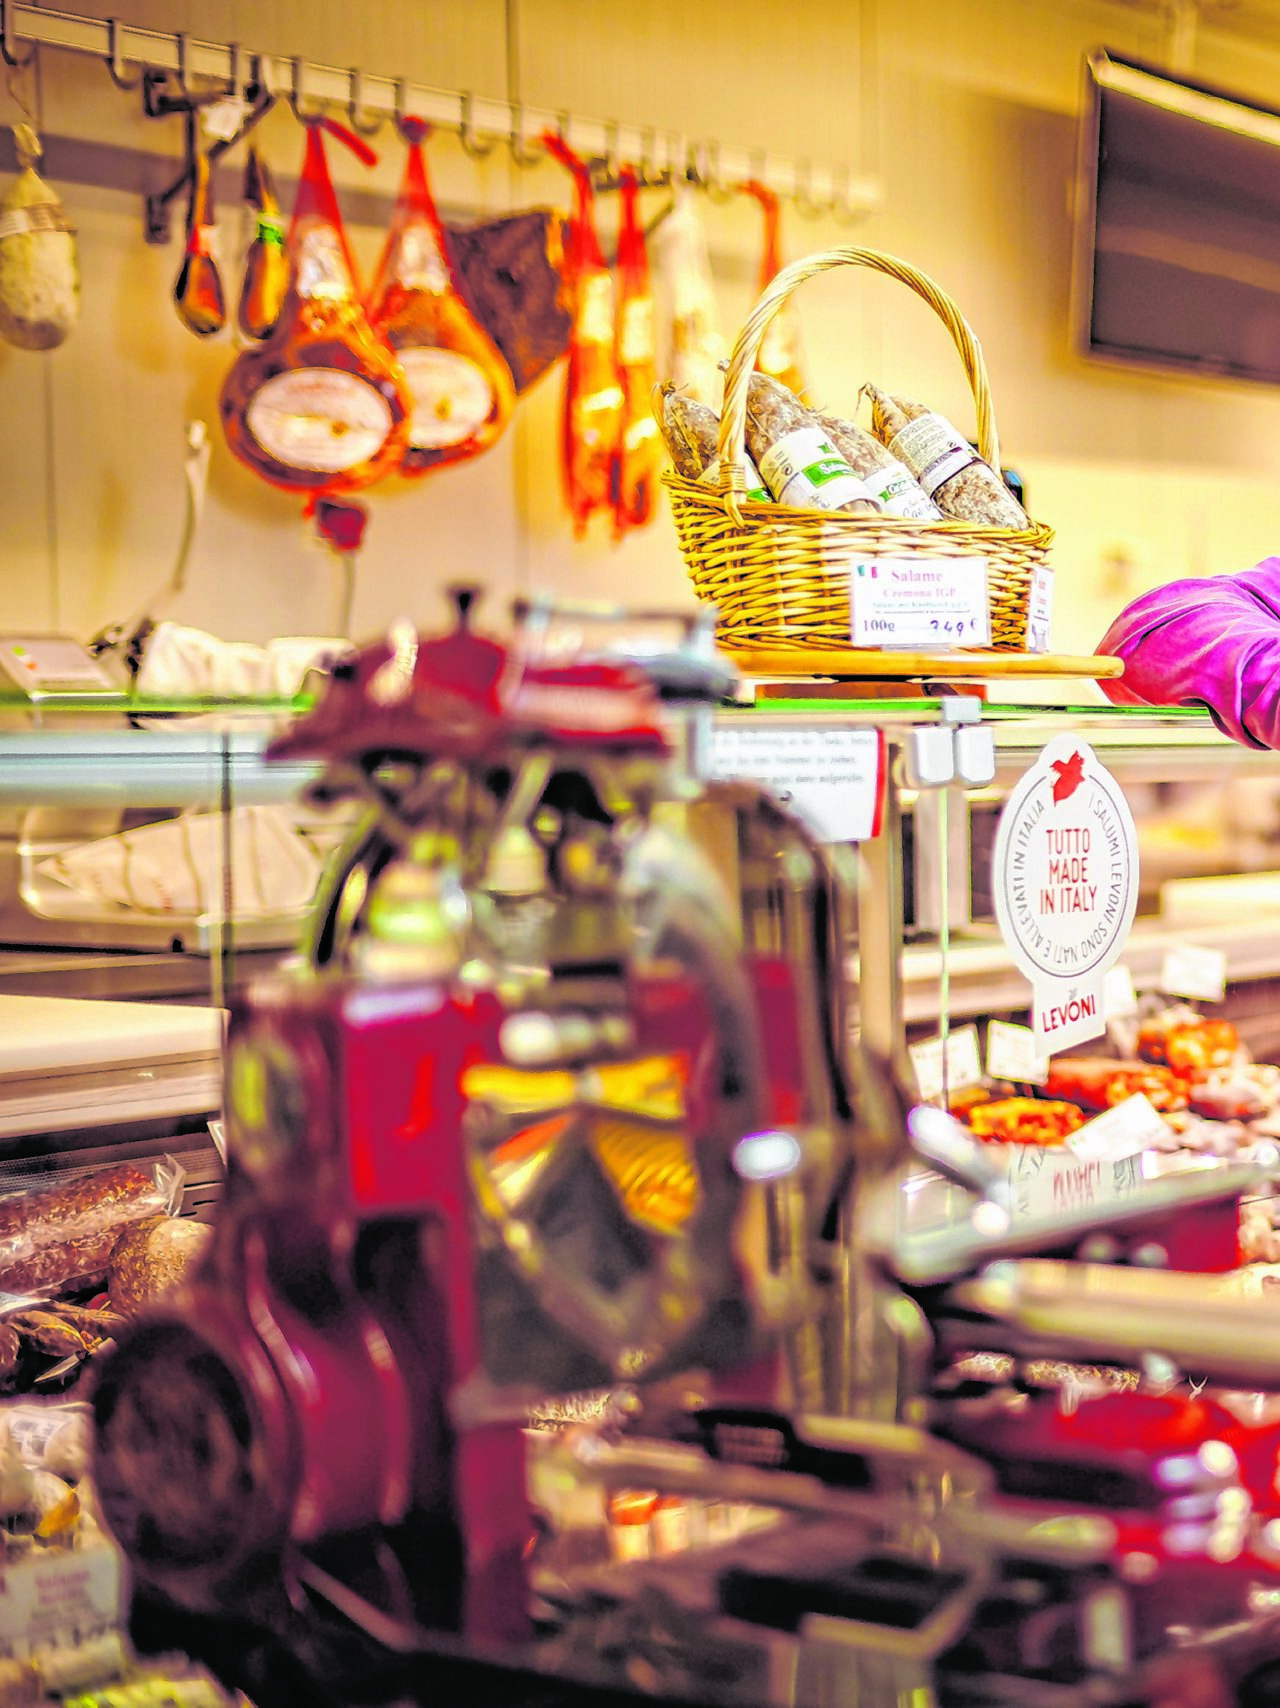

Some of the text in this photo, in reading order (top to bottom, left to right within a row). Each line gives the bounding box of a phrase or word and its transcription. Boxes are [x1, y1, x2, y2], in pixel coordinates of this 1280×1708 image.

[891, 569, 943, 583] Salame
[863, 619, 896, 633] 100g
[1018, 799, 1045, 846] ITALIA
[1094, 799, 1120, 857] SALUMI
[1045, 828, 1090, 854] TUTTO
[1013, 851, 1025, 870] IN
[1049, 857, 1088, 884] MADE
[1040, 885, 1098, 915] IN ITALY
[1103, 862, 1123, 924] LEVONI
[1013, 876, 1044, 948] ALLEVATI
[1081, 921, 1108, 958] SONO
[1042, 994, 1096, 1033] LEVONI
